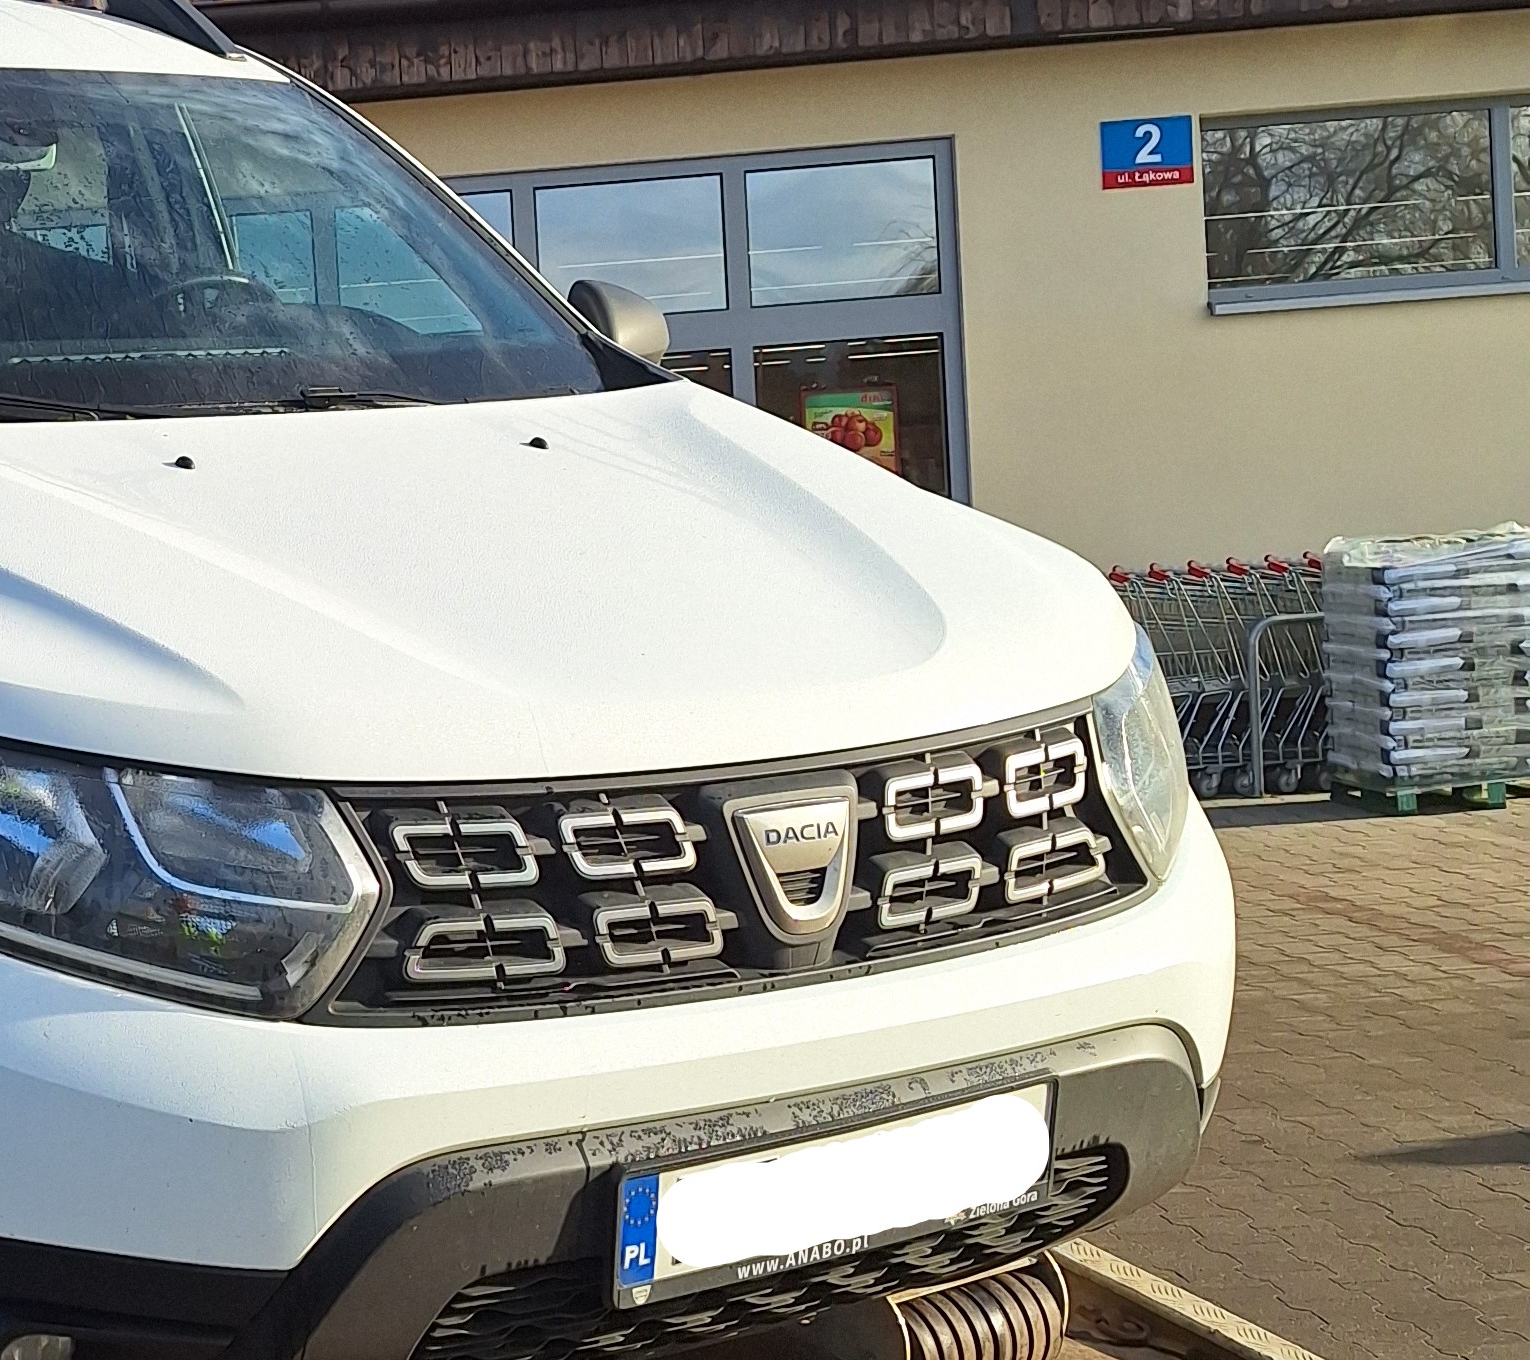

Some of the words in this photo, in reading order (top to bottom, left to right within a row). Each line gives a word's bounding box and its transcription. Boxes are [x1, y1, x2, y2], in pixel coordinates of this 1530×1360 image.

[1134, 123, 1163, 165] 2
[1117, 172, 1132, 184] ul.
[1134, 170, 1180, 184] Łąkowa
[764, 821, 839, 846] DACIA
[623, 1241, 651, 1271] PL
[737, 1234, 869, 1279] www.ANABO.pl
